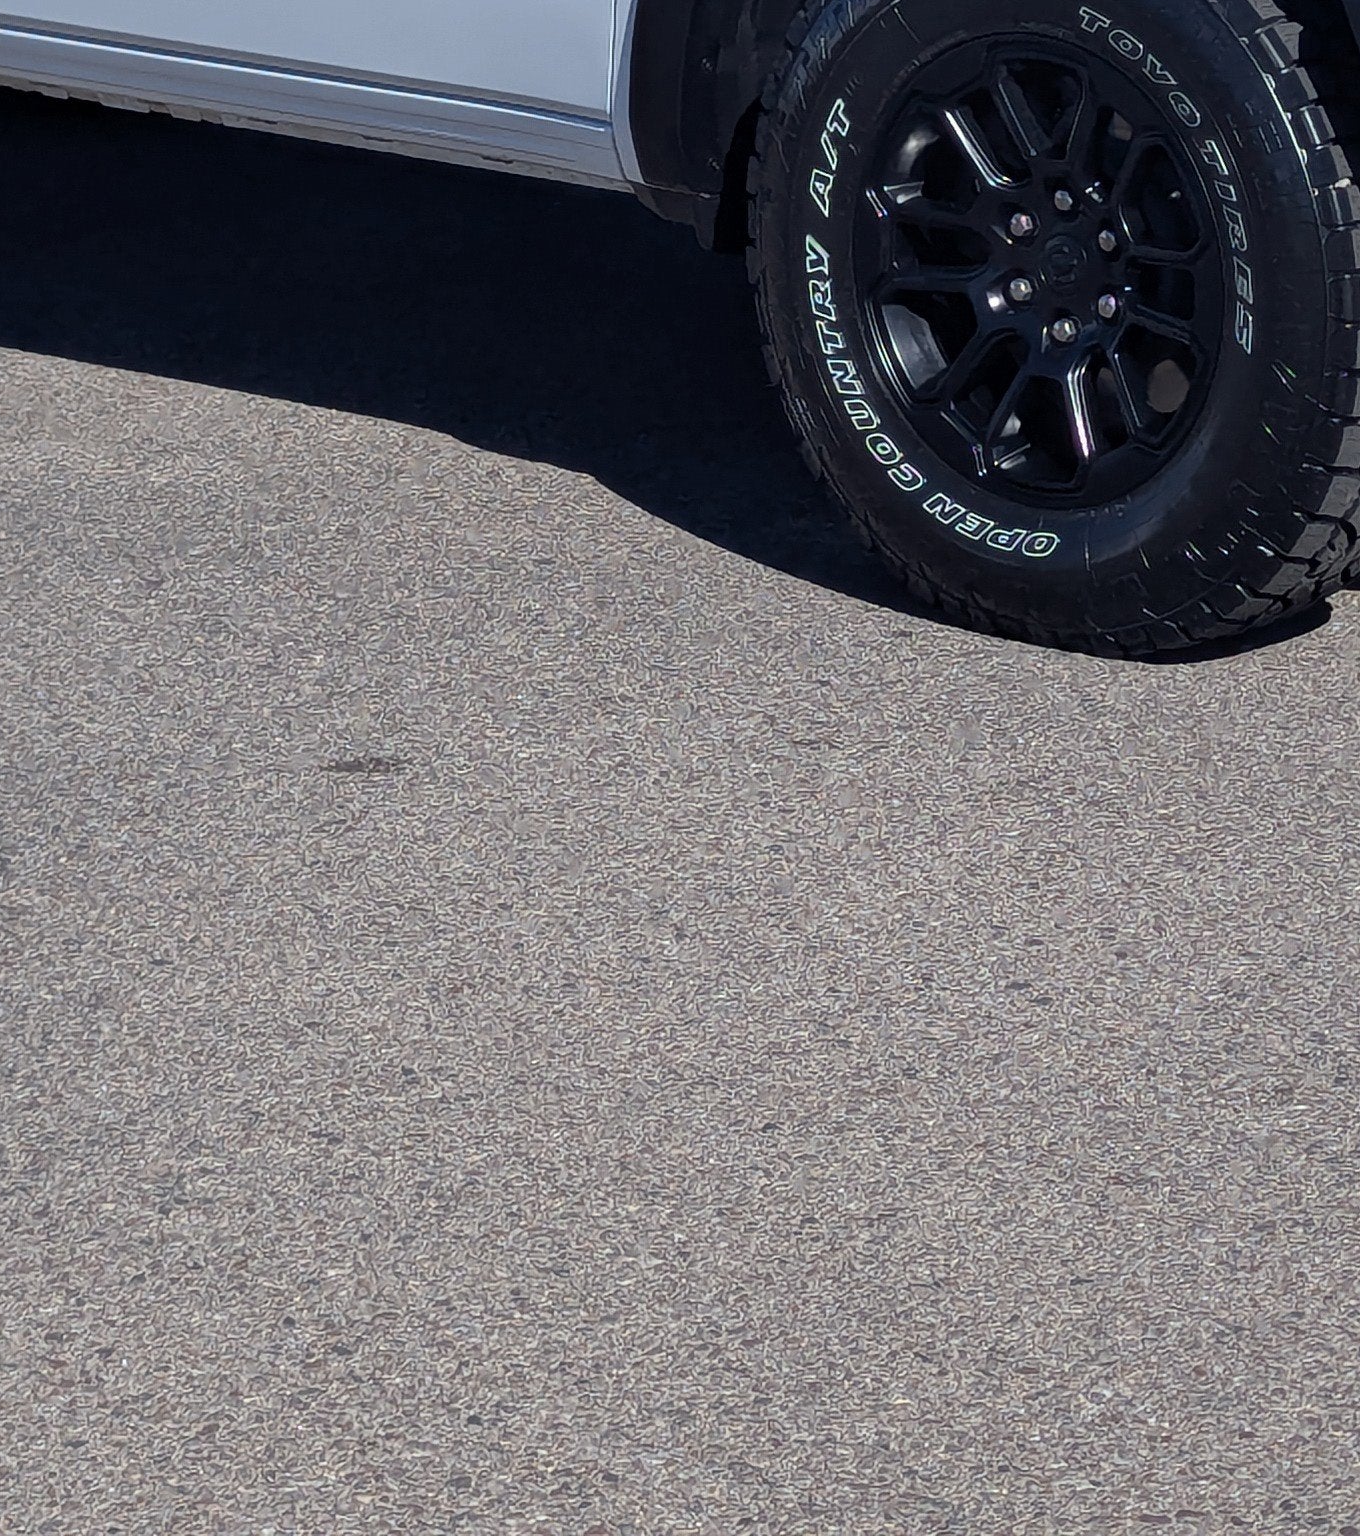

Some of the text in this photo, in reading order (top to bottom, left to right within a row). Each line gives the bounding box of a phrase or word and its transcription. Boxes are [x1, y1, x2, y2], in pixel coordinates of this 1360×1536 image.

[805, 97, 1061, 558] OPEN COUNTRY A/T
[1078, 5, 1255, 356] TOYO TIRES
